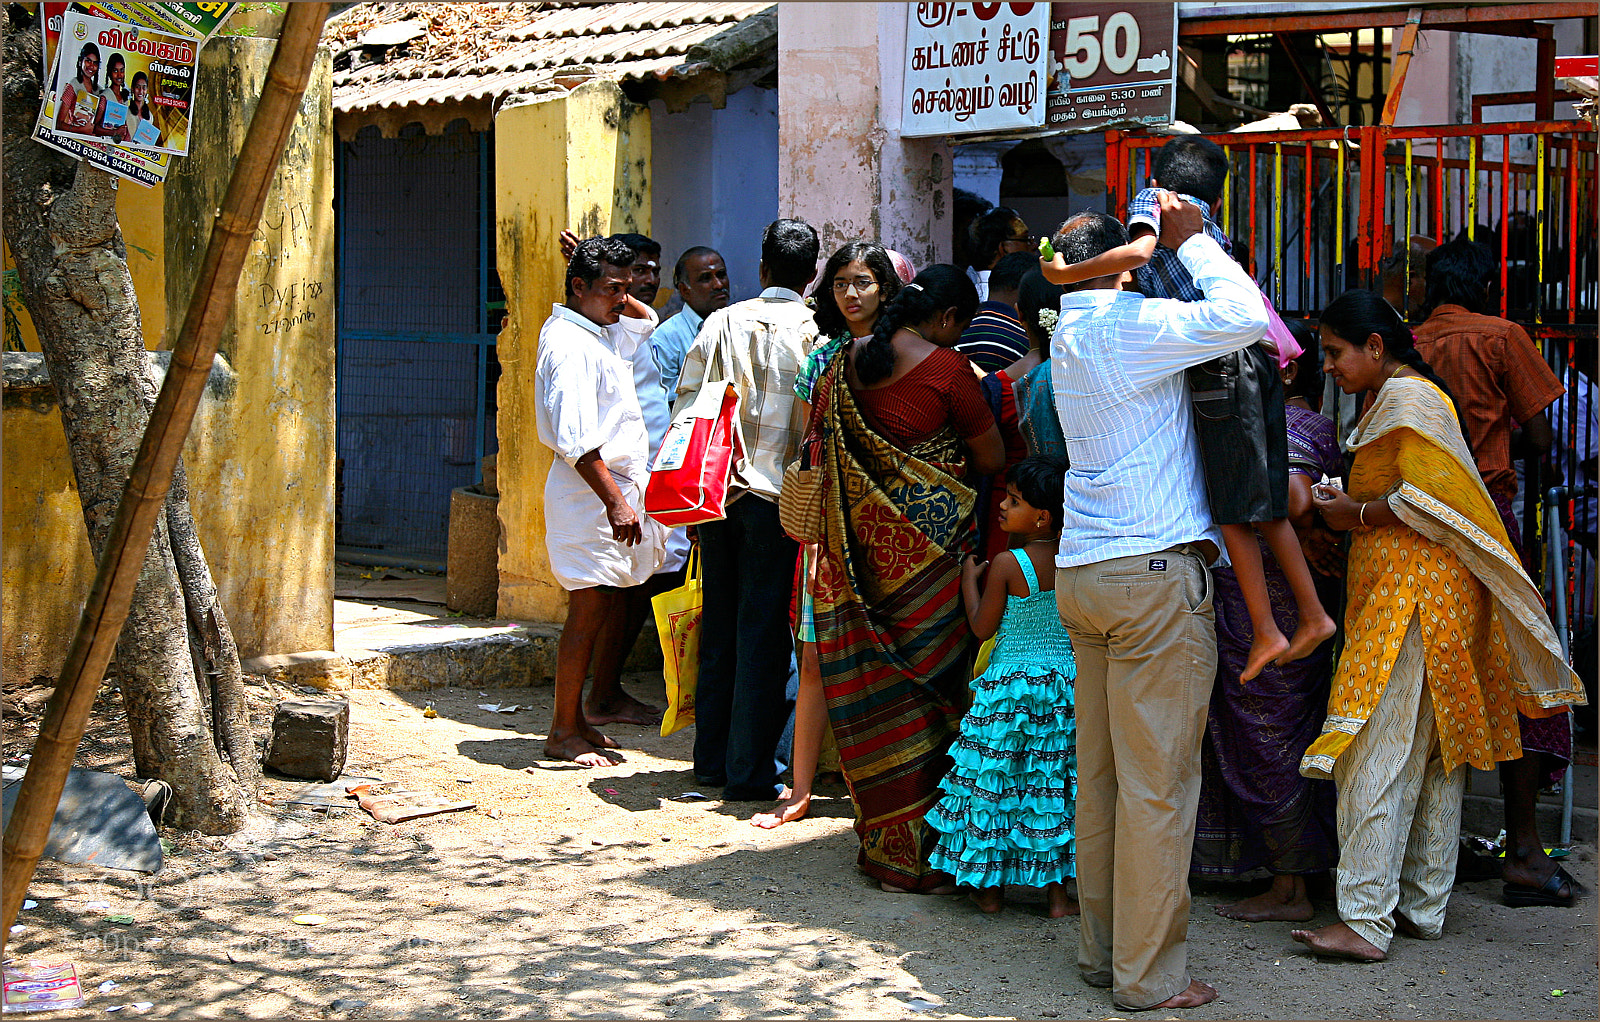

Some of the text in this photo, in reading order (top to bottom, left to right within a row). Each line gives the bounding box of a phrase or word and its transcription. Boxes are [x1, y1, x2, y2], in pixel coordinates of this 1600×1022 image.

[1051, 21, 1066, 30] ket
[98, 28, 193, 63] விவேகம்
[911, 24, 1040, 70] கட்டணச் சீட்டு
[149, 60, 191, 77] ஸ்கூல்
[912, 70, 1037, 121] செல்லும் வழி
[1076, 94, 1106, 104] காலை
[1111, 89, 1136, 100] 5.30
[1141, 86, 1164, 98] மணி
[1051, 103, 1127, 123] முதல் இயங்கும்
[57, 135, 81, 152] 99433
[82, 148, 110, 166] 63964,
[112, 158, 136, 174] 94431
[137, 169, 159, 184] 04840
